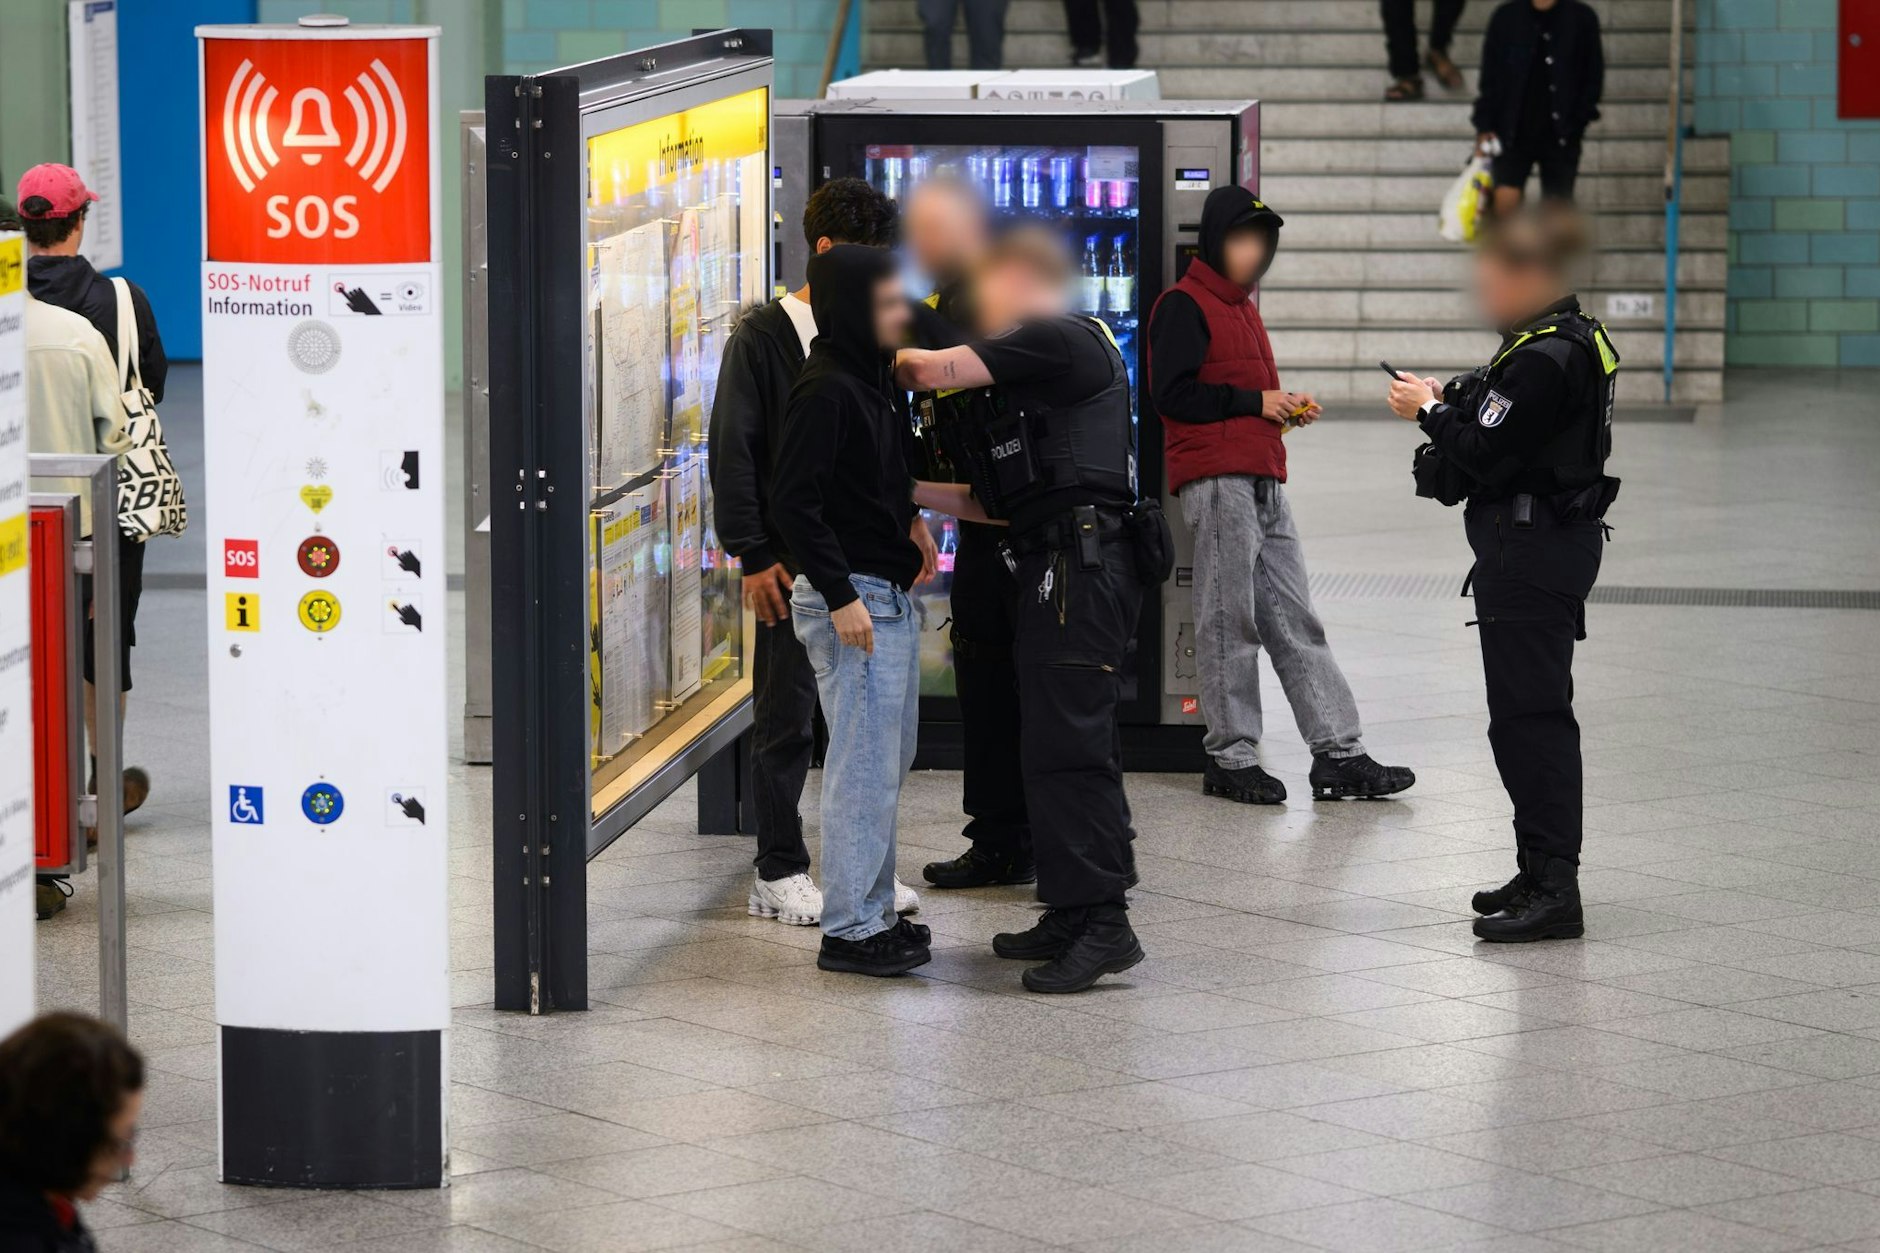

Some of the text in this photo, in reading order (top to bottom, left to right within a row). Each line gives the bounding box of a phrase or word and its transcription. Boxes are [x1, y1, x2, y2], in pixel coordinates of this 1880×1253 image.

[659, 129, 704, 177] Information
[266, 195, 360, 239] SOS
[207, 273, 312, 292] SOS-Notruf
[207, 297, 313, 316] Information
[990, 438, 1021, 460] POLIZEI
[227, 551, 256, 567] SOS
